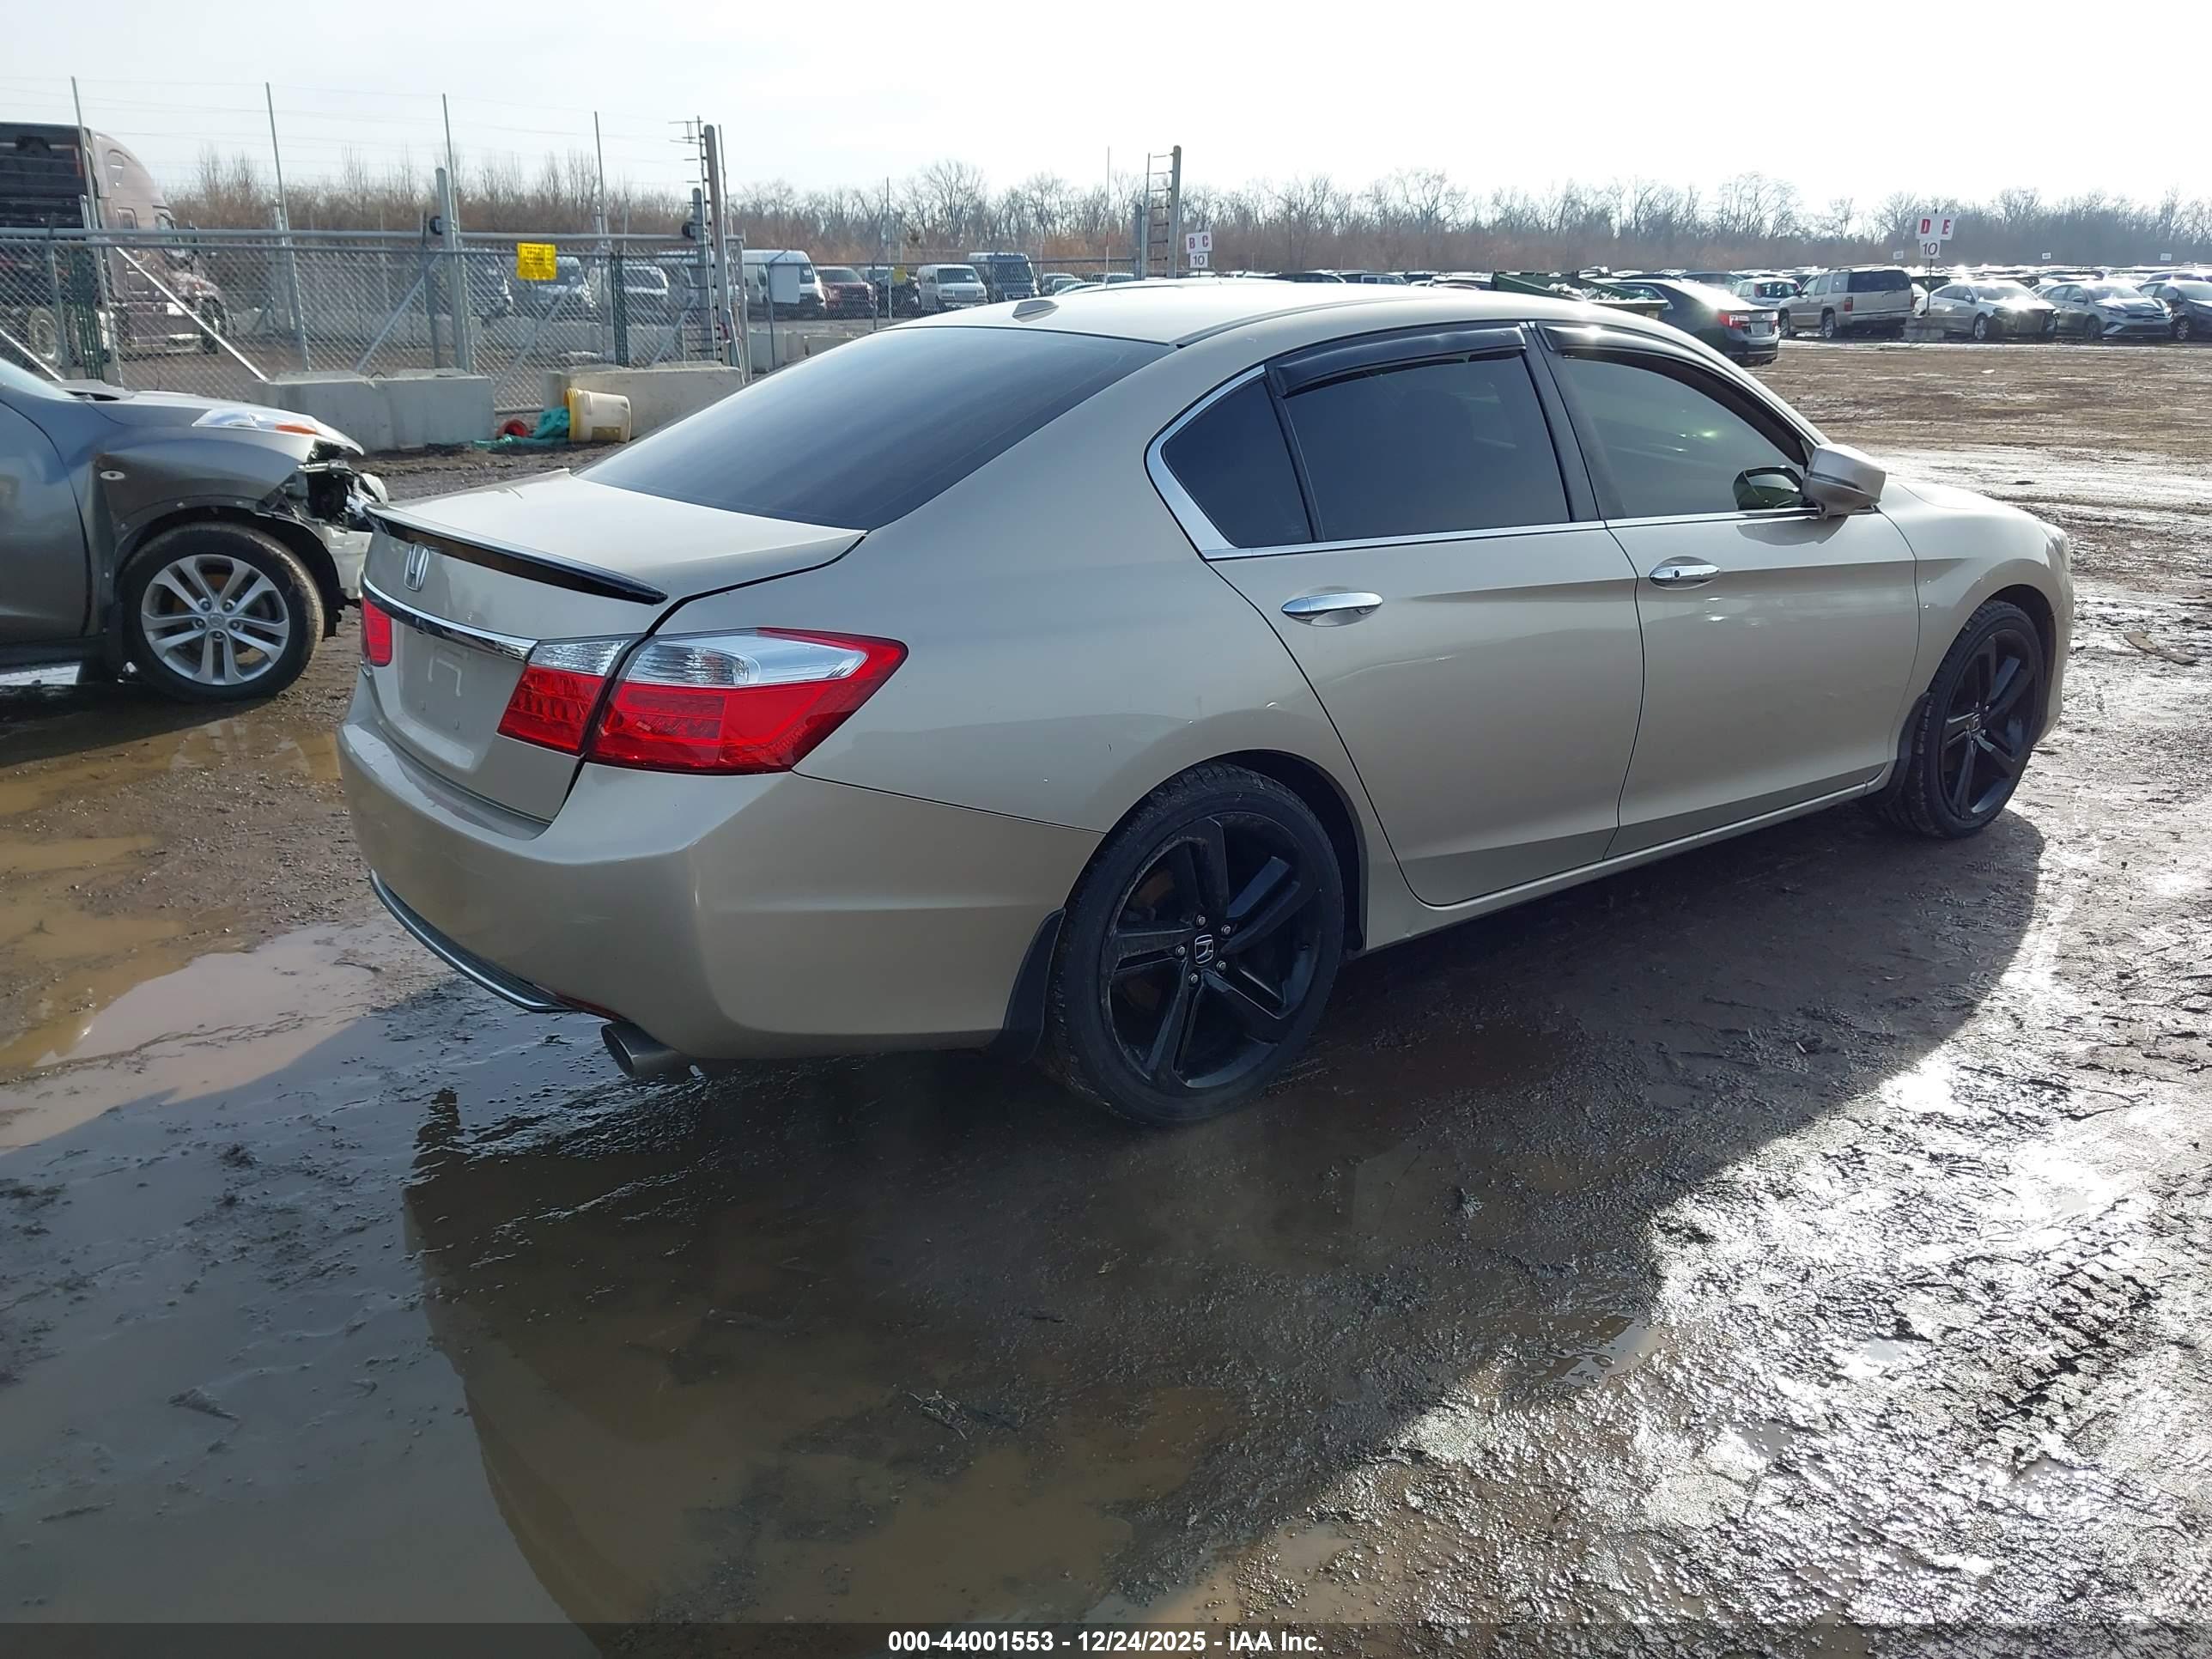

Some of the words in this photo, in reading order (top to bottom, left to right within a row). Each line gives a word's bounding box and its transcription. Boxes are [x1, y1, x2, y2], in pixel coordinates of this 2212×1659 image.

[1920, 219, 1931, 234] D
[1942, 219, 1951, 234] E
[1188, 237, 1195, 249] B
[1202, 235, 1209, 248] C
[1923, 242, 1938, 256] 10
[1193, 255, 1206, 265] 10
